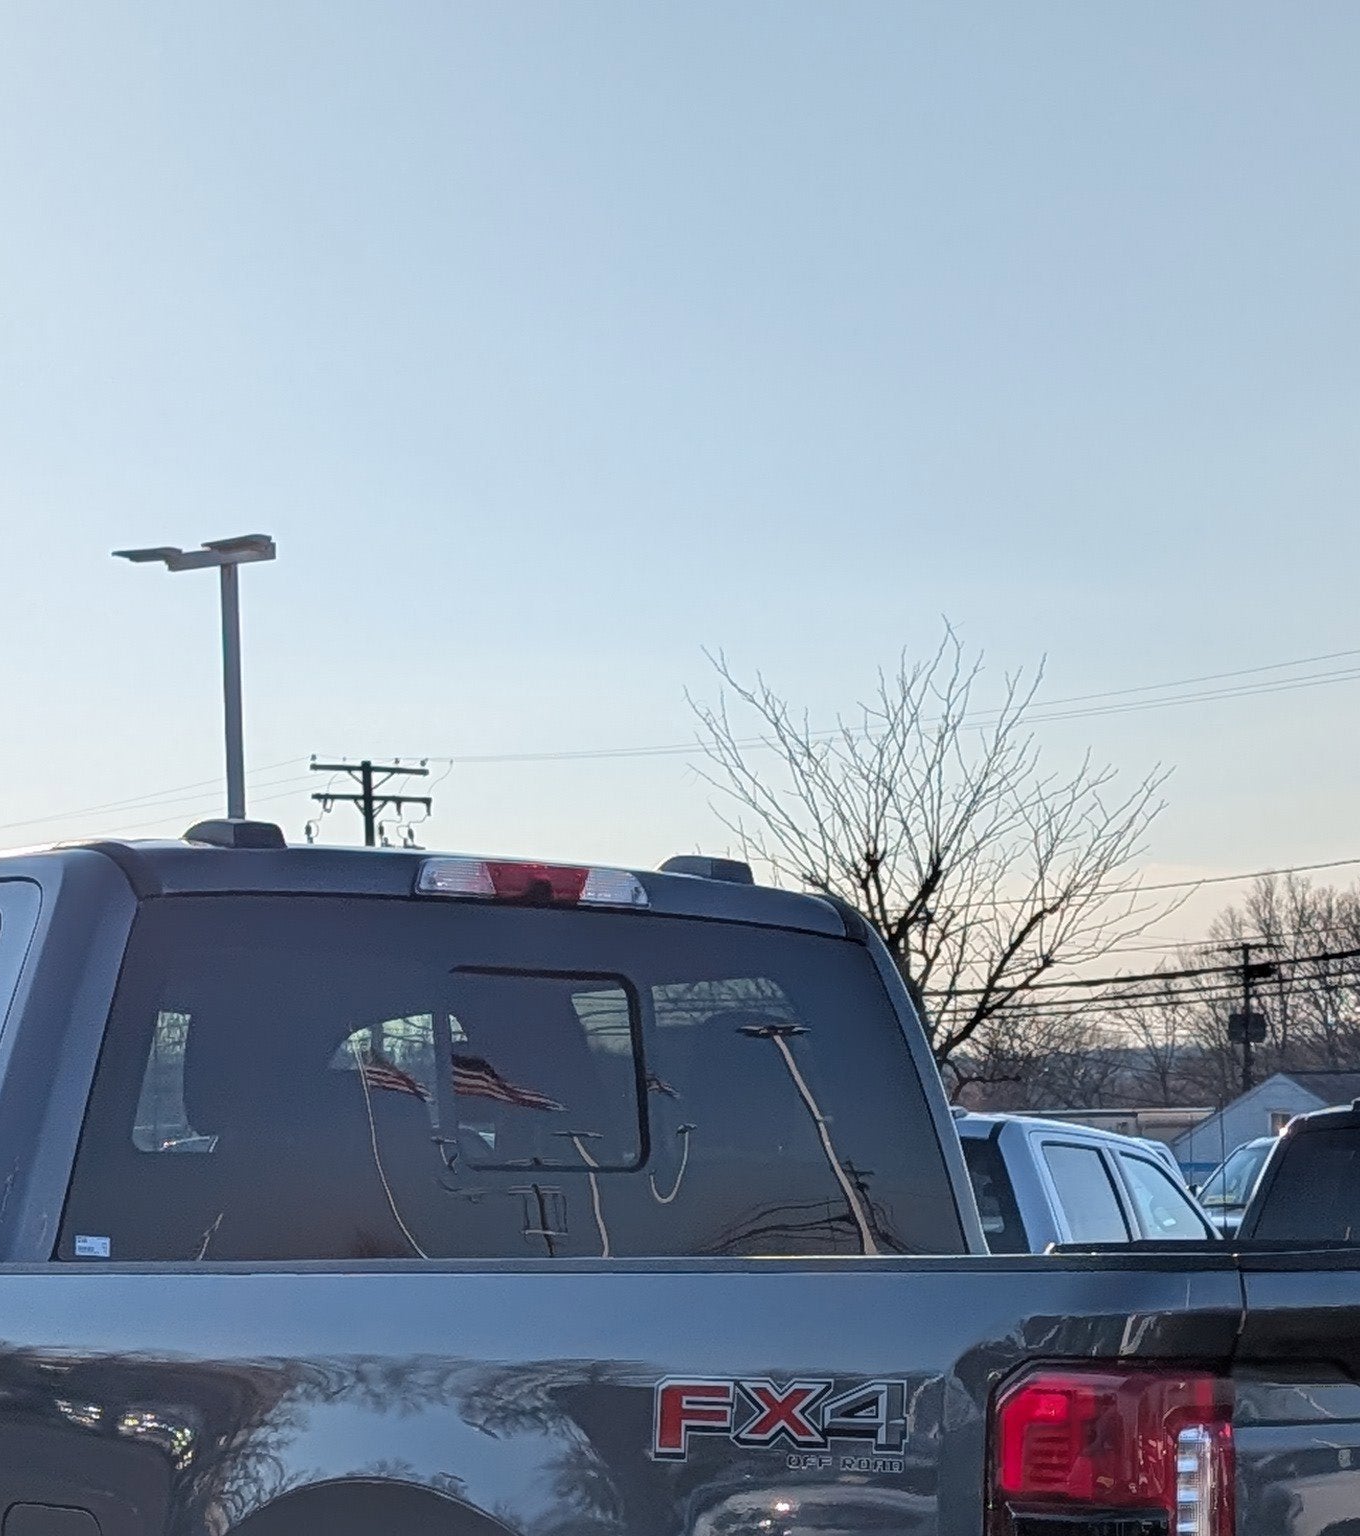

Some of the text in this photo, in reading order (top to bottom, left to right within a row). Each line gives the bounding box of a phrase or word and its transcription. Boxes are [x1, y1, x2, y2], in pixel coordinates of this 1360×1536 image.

[651, 1375, 910, 1462] FX4
[786, 1454, 905, 1473] OFF ROAD
